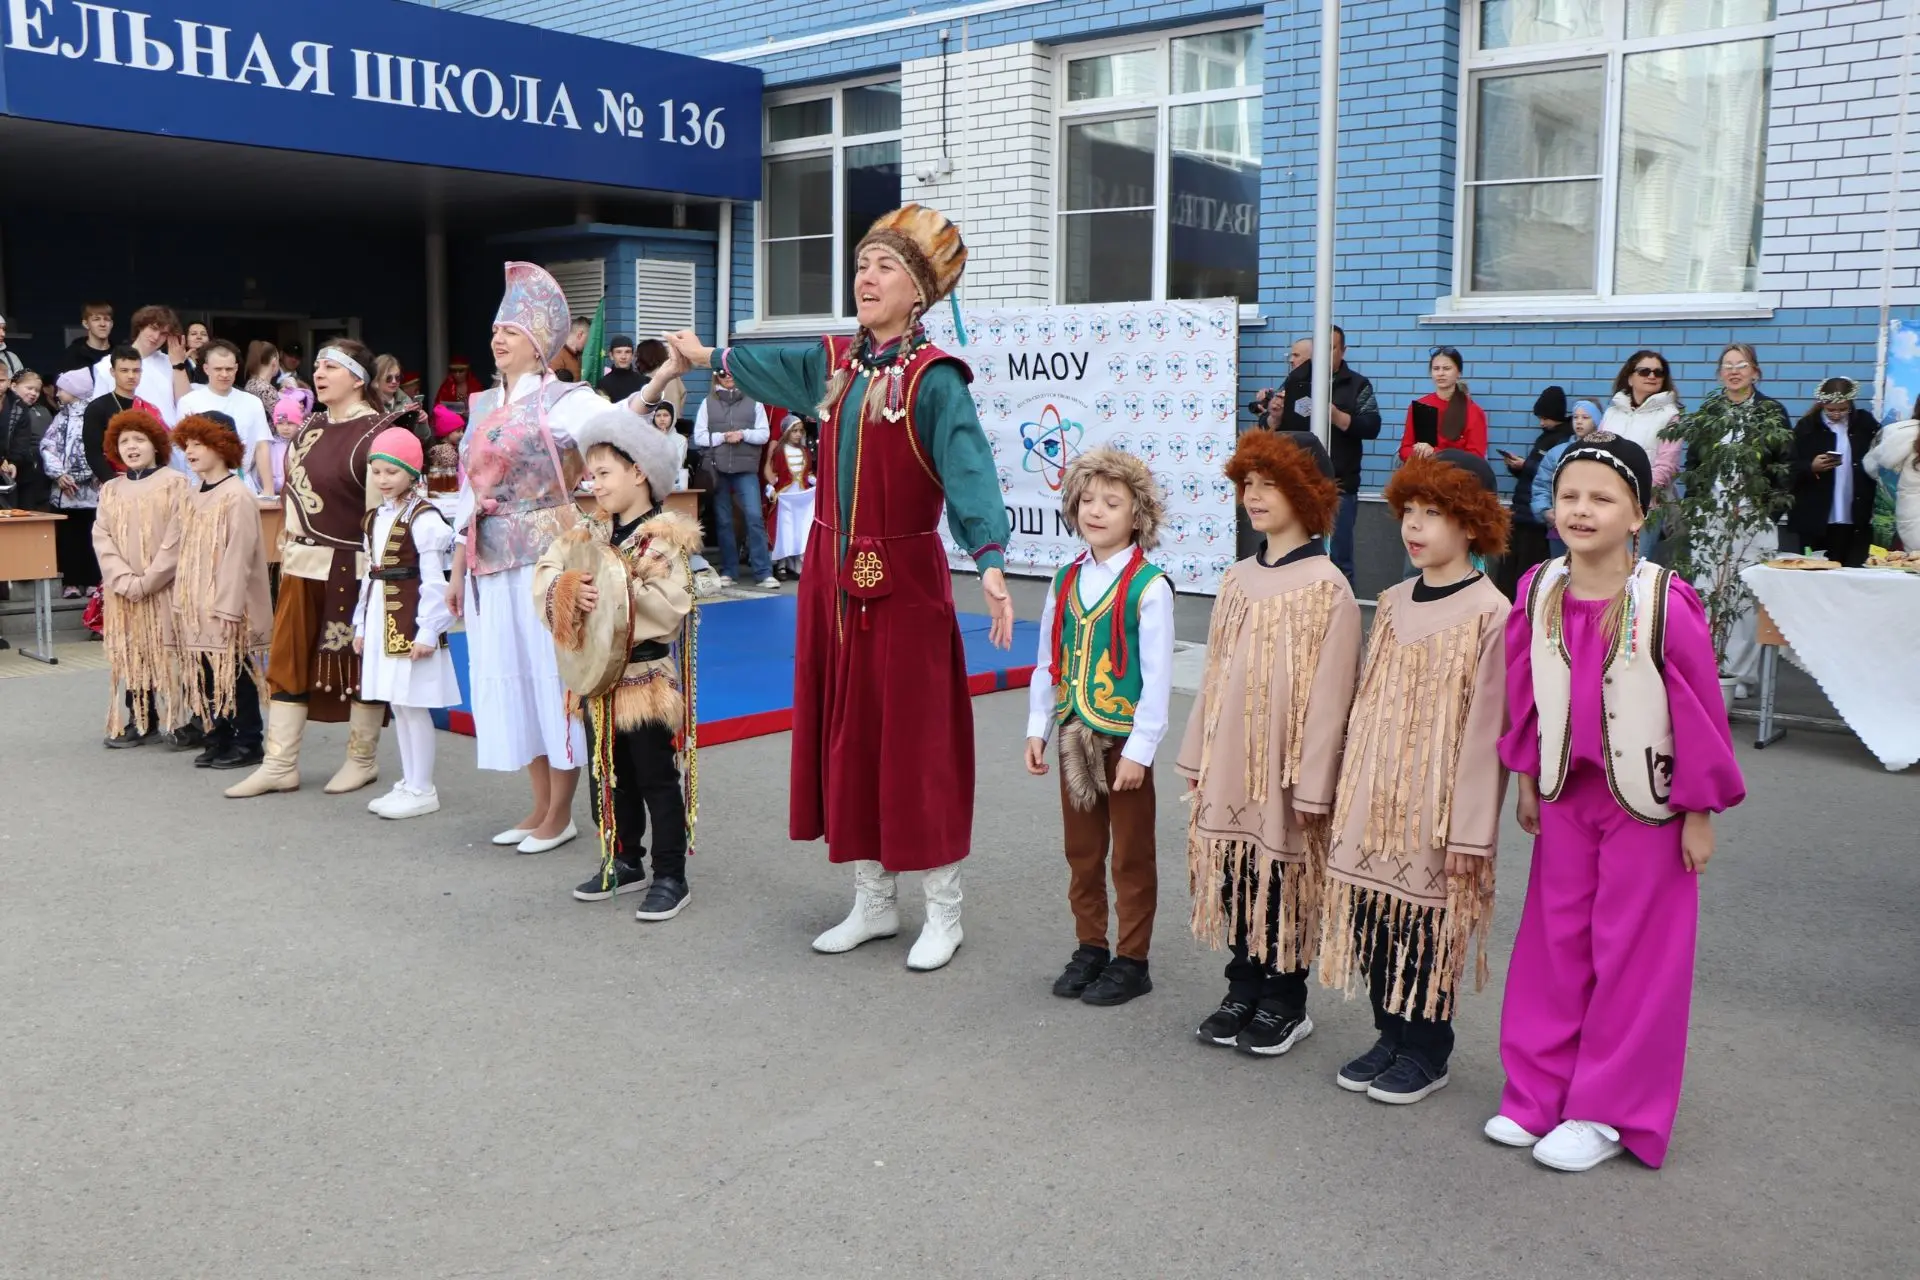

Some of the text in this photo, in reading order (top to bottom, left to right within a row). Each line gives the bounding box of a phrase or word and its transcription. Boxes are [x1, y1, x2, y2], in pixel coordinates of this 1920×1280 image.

[5, 0, 725, 150] ЕЛЬНАЯ ШКОЛА № 136
[1008, 351, 1089, 381] МАОУ
